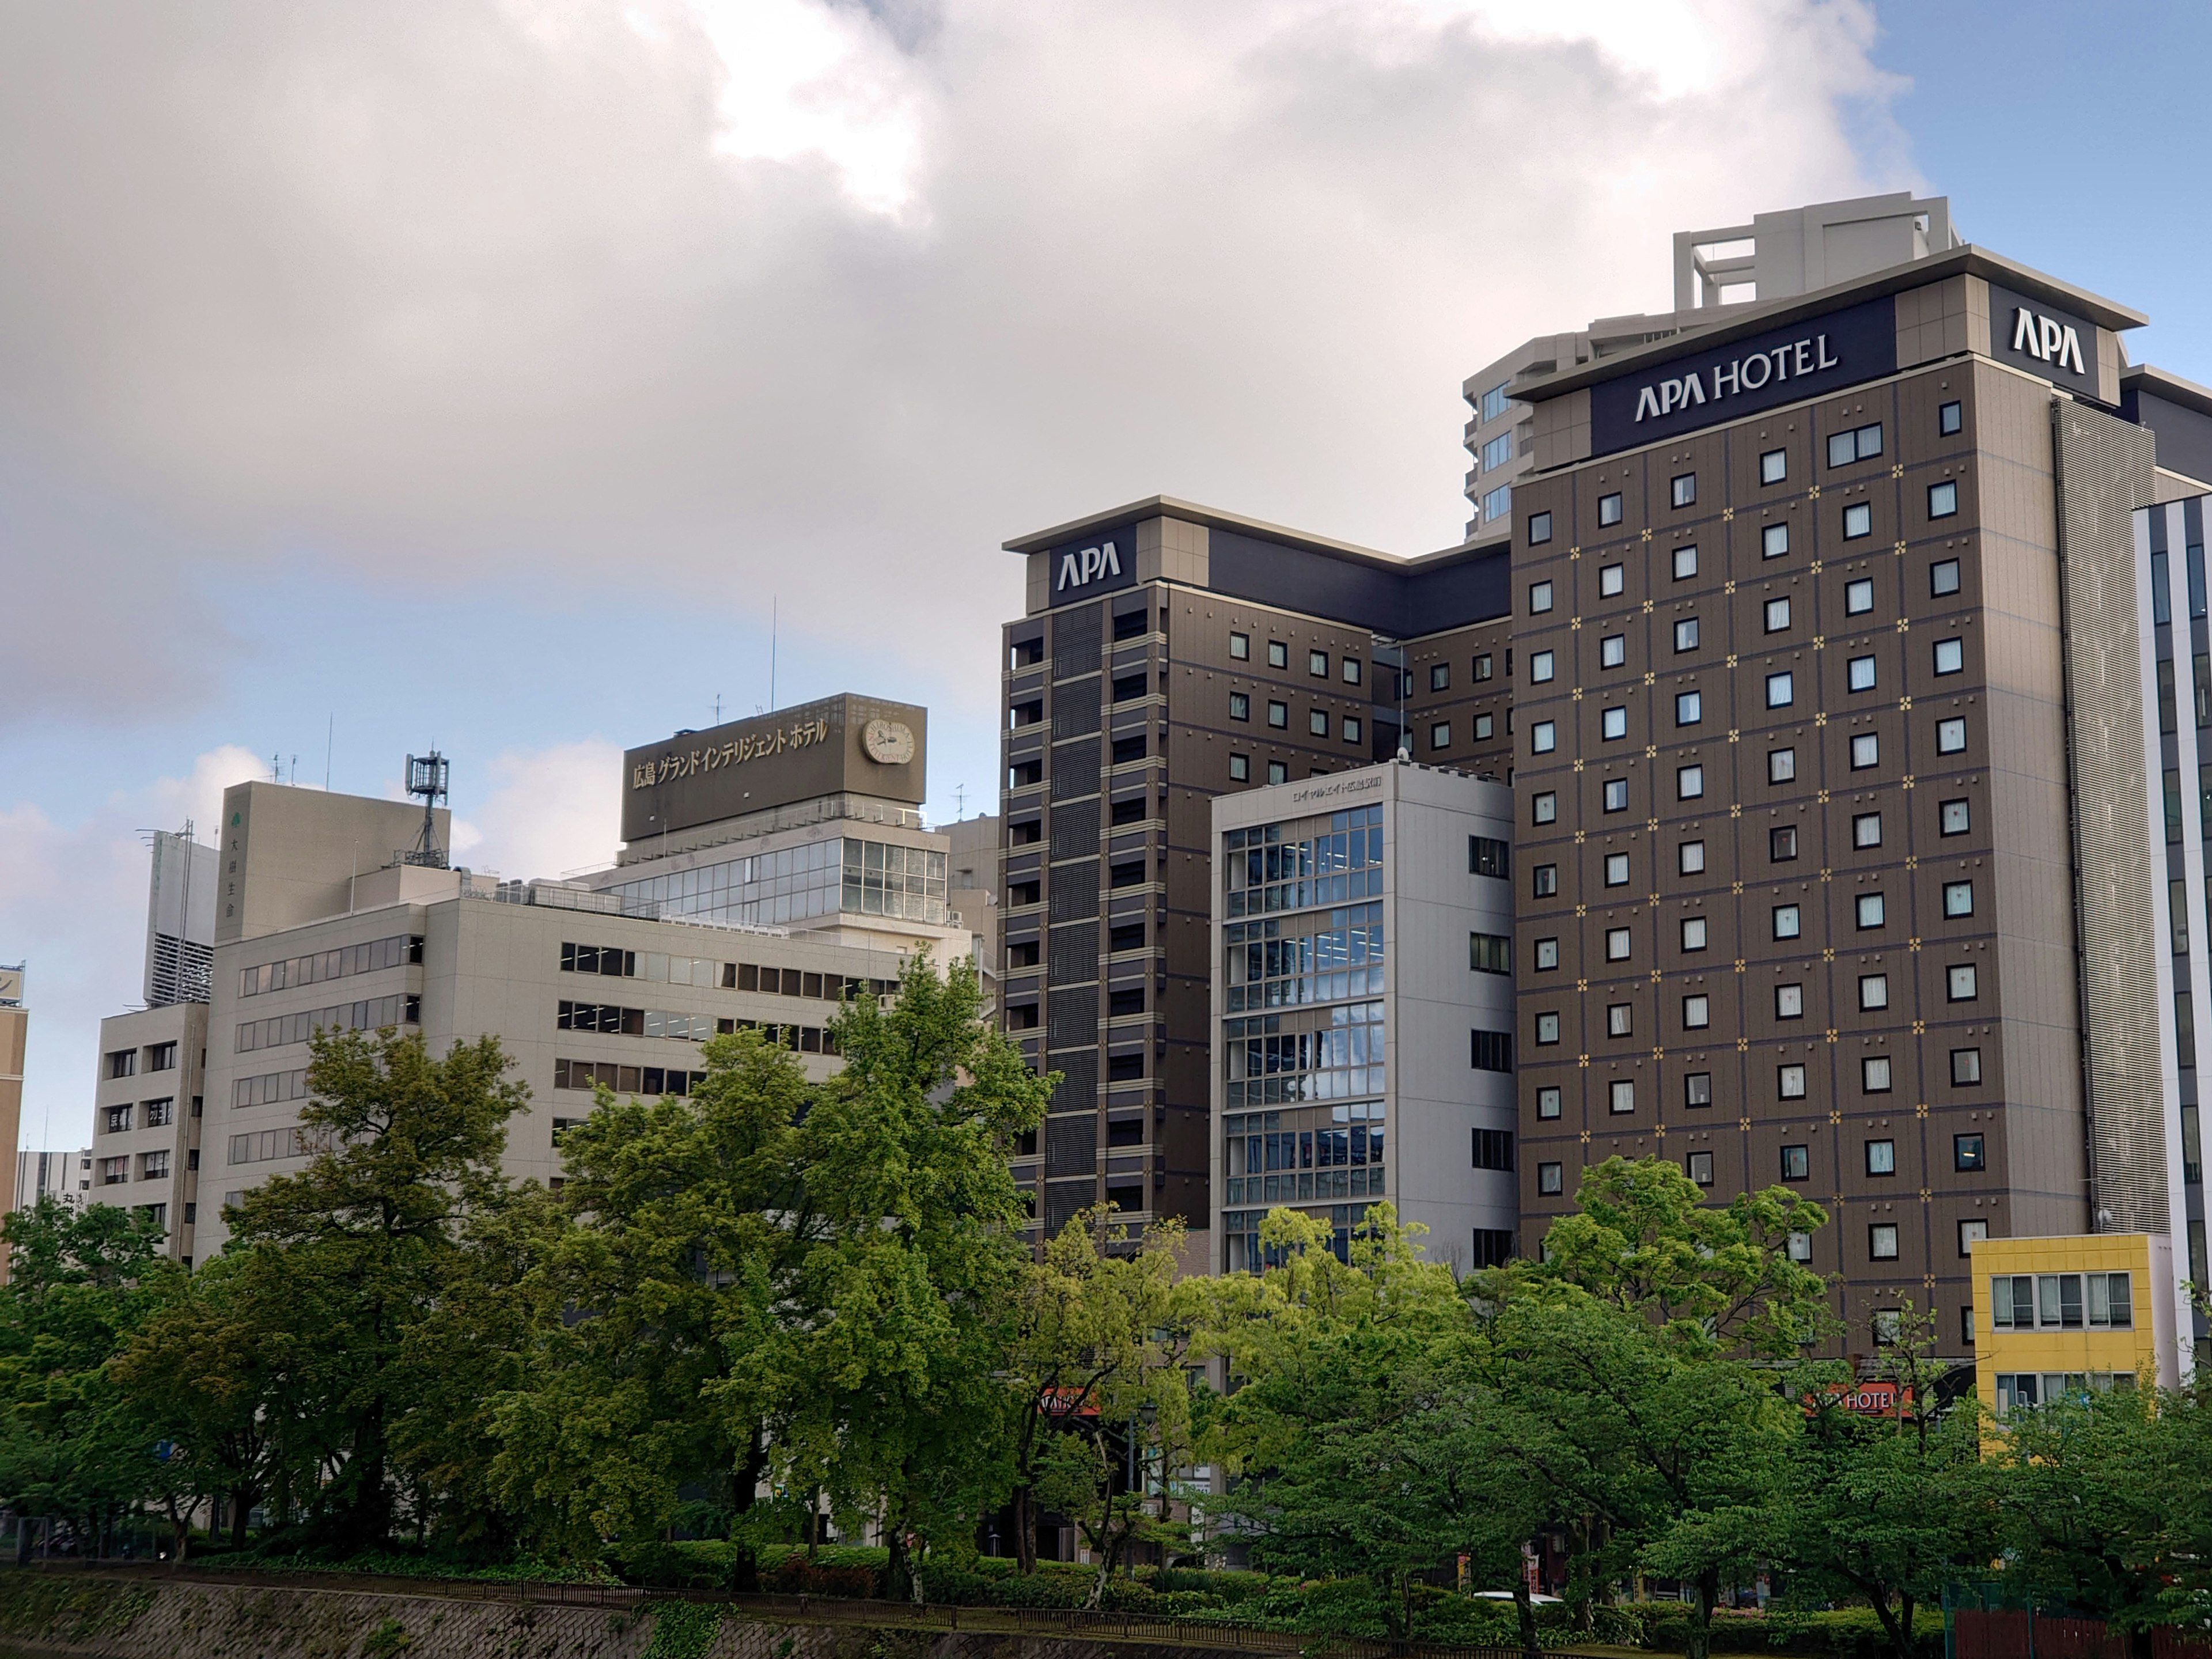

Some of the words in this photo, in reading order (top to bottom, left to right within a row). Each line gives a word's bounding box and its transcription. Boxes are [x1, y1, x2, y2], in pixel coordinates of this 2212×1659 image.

[2013, 306, 2086, 375] APA
[1635, 372, 1706, 422] APA
[1713, 334, 1839, 400] HOTEL
[1057, 541, 1121, 592] APA
